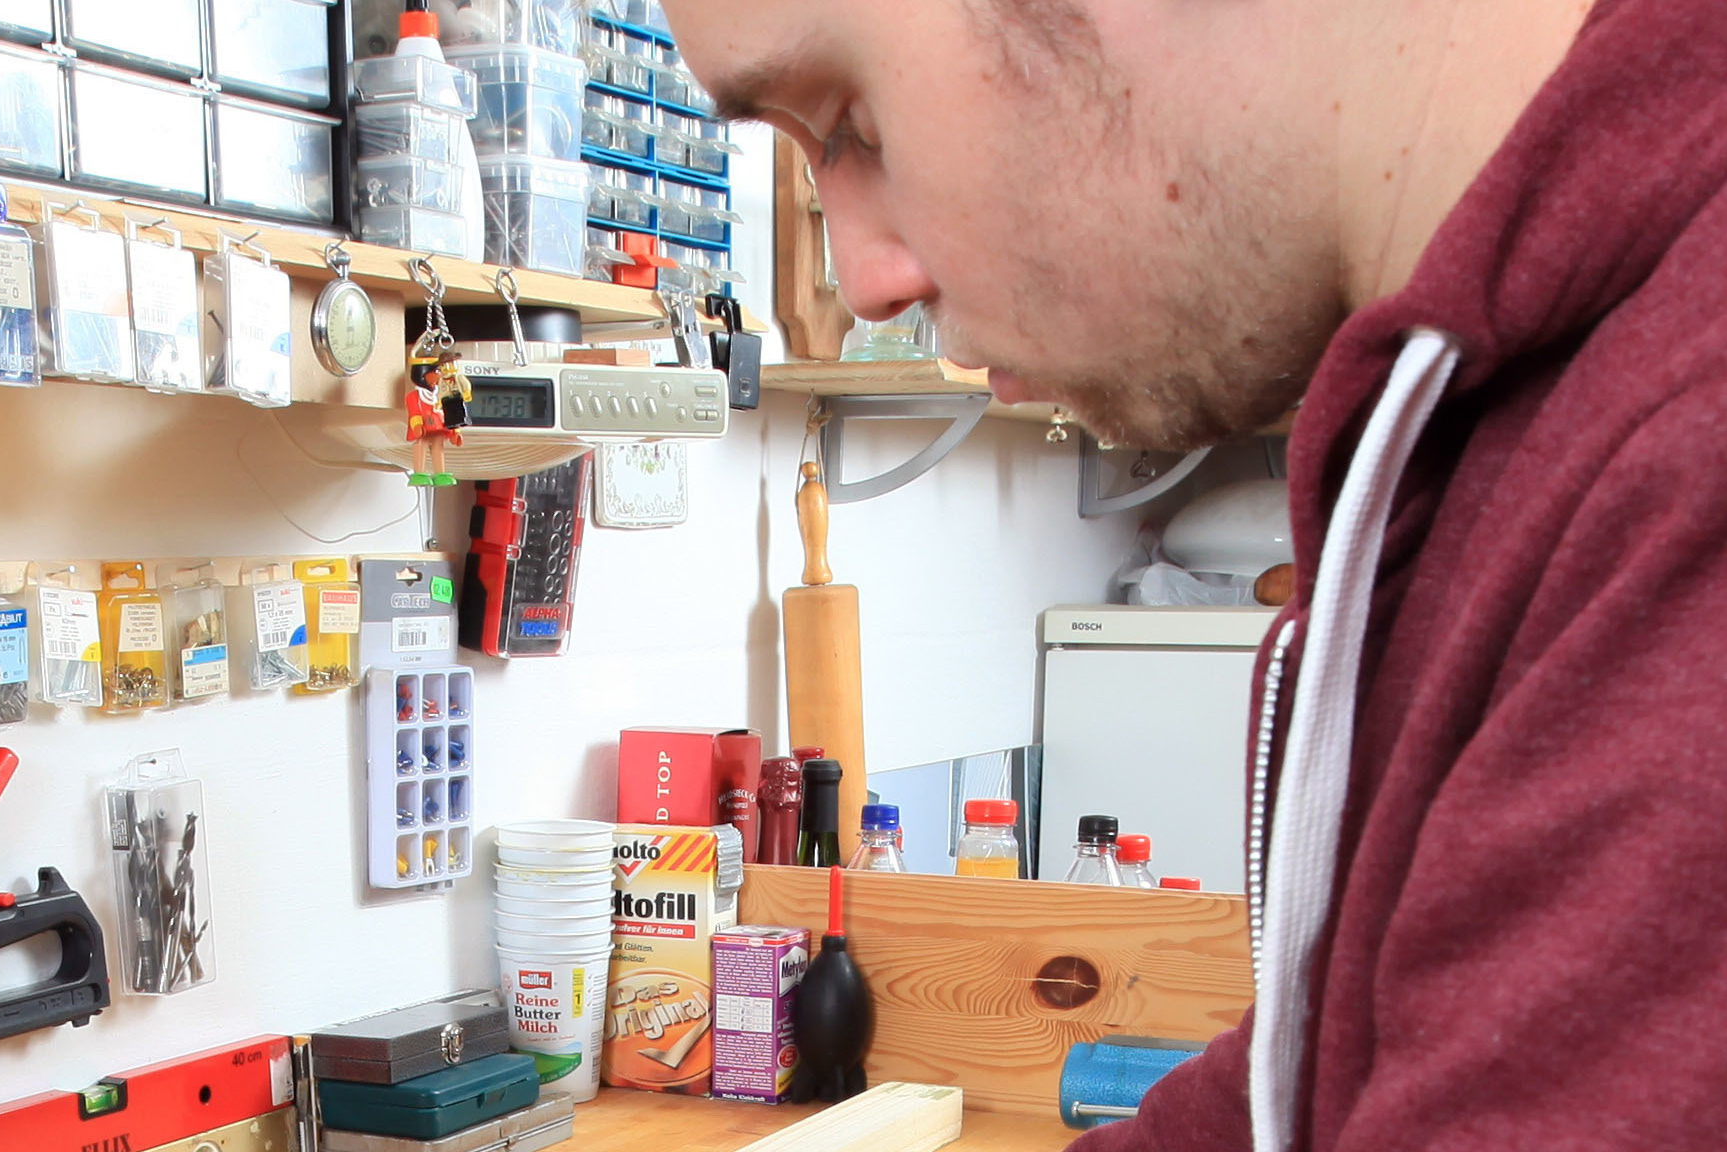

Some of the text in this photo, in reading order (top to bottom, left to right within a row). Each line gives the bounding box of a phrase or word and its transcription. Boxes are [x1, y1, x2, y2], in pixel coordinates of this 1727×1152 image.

[464, 366, 500, 376] SONY
[524, 606, 561, 619] ALPHA
[1072, 622, 1102, 631] BOSCH
[656, 750, 672, 798] TOP
[643, 924, 657, 934] für
[520, 973, 549, 986] müller
[515, 992, 560, 1008] Reine
[612, 982, 680, 1009] Das
[514, 1005, 562, 1021] Butter
[518, 1019, 559, 1034] Milch
[231, 1051, 262, 1068] 40 cm
